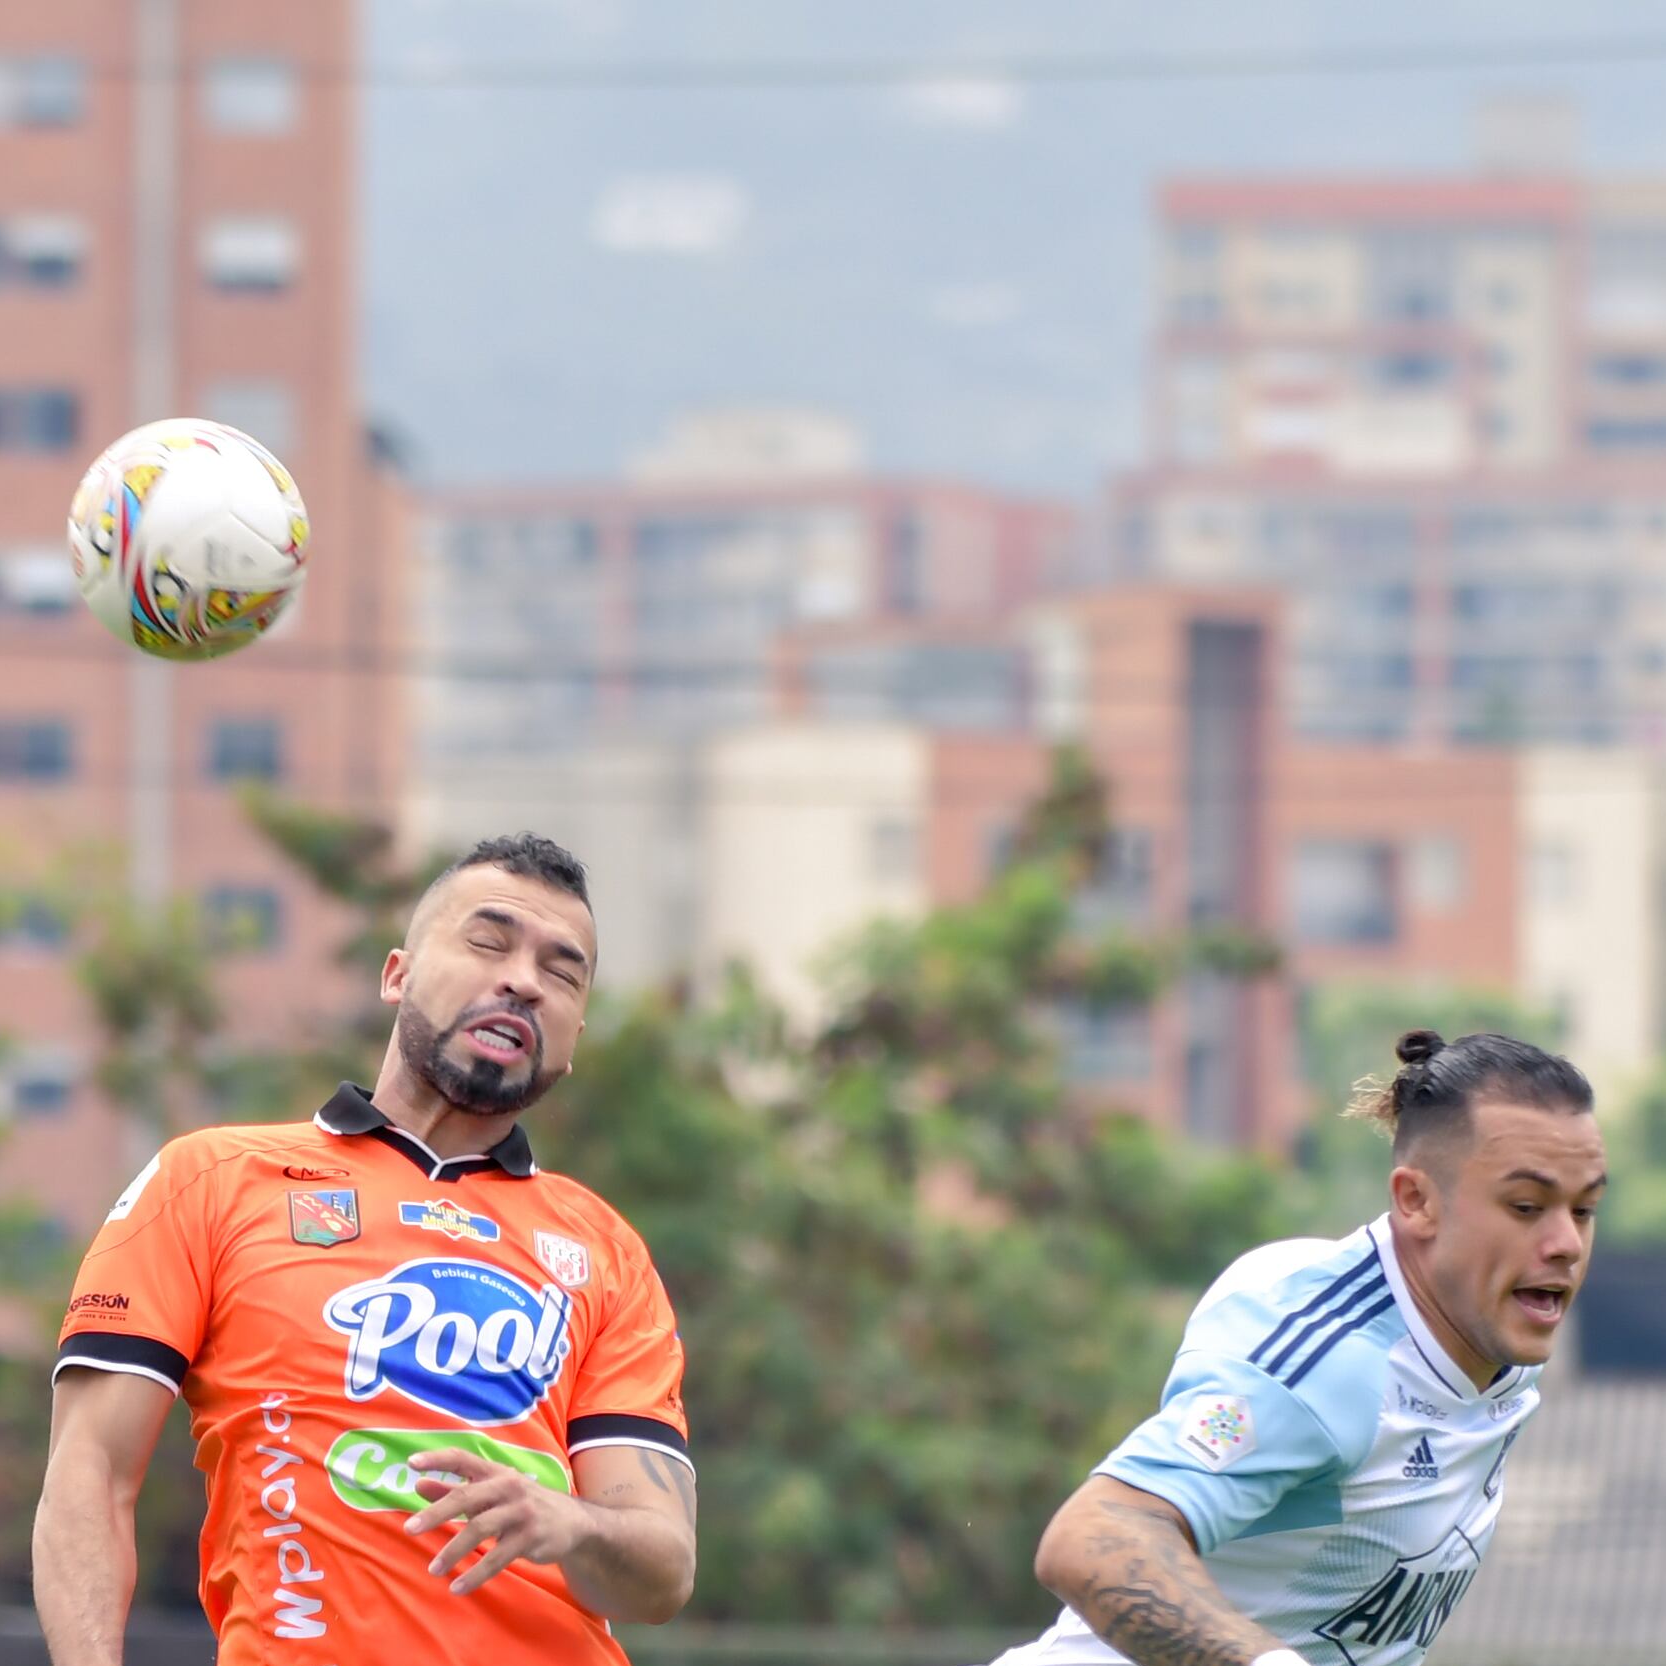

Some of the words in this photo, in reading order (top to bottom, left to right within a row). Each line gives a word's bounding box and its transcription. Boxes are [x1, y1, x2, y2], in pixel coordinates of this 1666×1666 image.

[431, 1267, 477, 1280] Bebida
[330, 1282, 569, 1393] Pool
[1402, 1465, 1439, 1479] adidas
